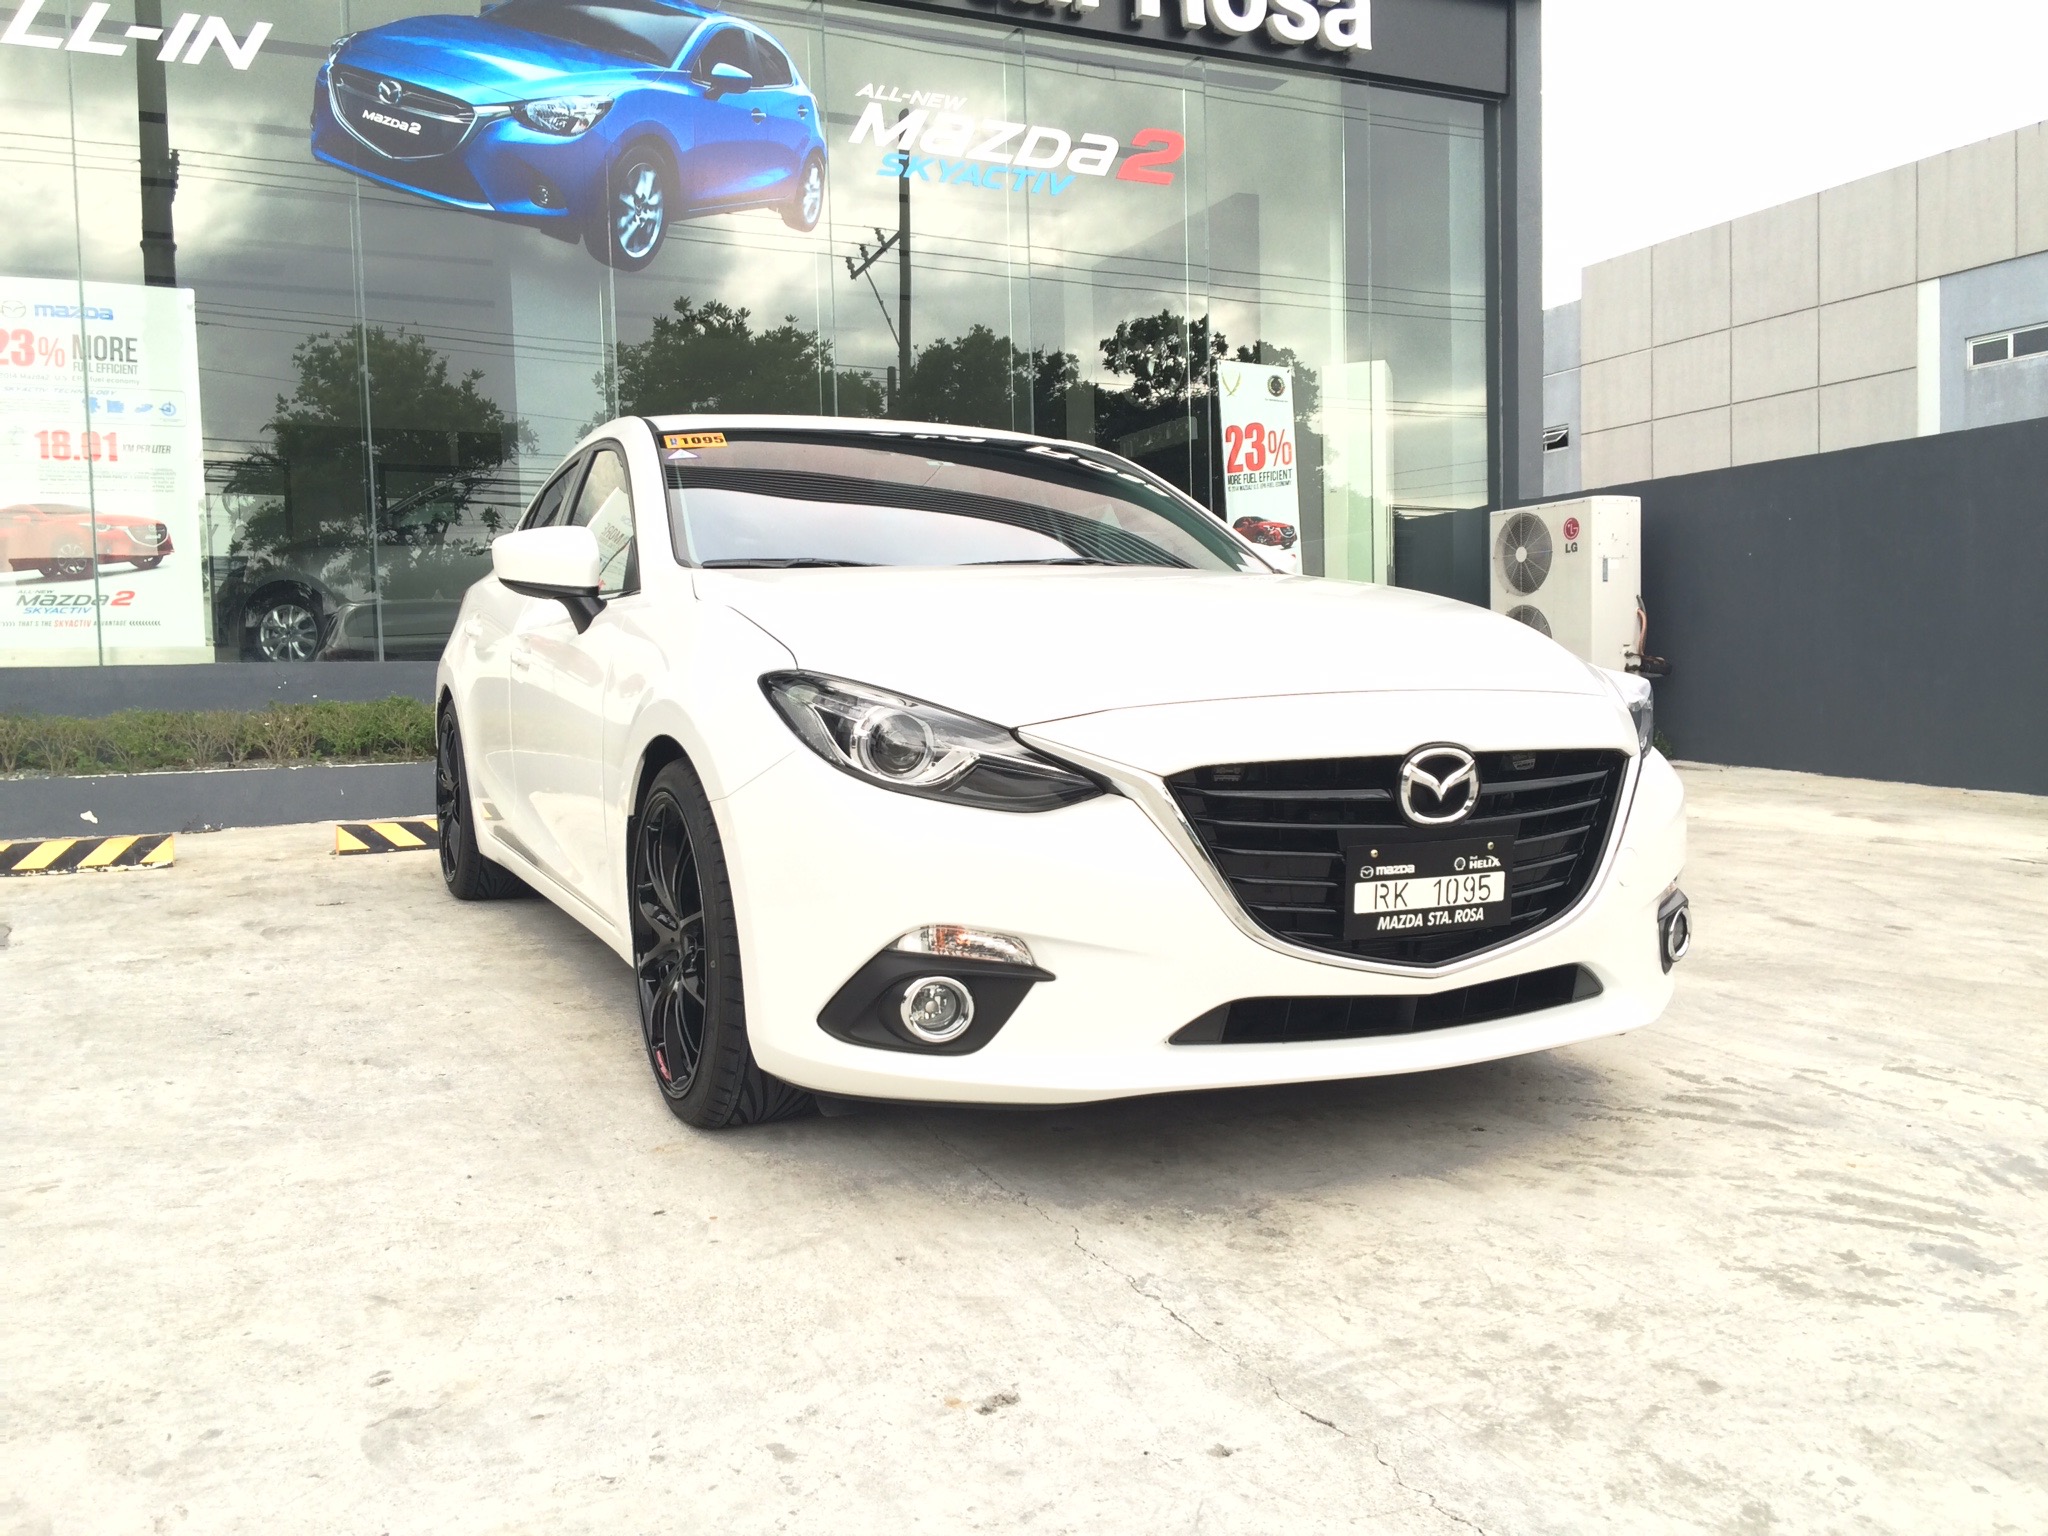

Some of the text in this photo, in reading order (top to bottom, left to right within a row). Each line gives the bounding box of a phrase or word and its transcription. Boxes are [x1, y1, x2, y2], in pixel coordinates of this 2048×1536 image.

[855, 83, 967, 111] ALL-NEW
[877, 153, 1077, 196] SKYACTIV
[72, 334, 139, 363] MORE
[72, 361, 139, 375] FUL EFFICIENT
[53, 386, 118, 396] TECHNLOGY
[34, 429, 119, 462] 18.01
[681, 436, 724, 445] 1095
[1225, 422, 1292, 473] 23%
[136, 444, 151, 454] PER
[151, 445, 172, 454] LITER
[1243, 473, 1258, 485] FUEL
[1259, 469, 1292, 483] EFFICIENT
[1565, 542, 1578, 554] LG
[23, 607, 92, 615] SKYACTIV
[54, 619, 92, 628] SKYACTIV
[1375, 864, 1415, 876] mazda
[1469, 855, 1501, 870] HELIX
[1374, 874, 1491, 910] RK 1095
[1377, 907, 1484, 931] MAZDA STA. ROSA
